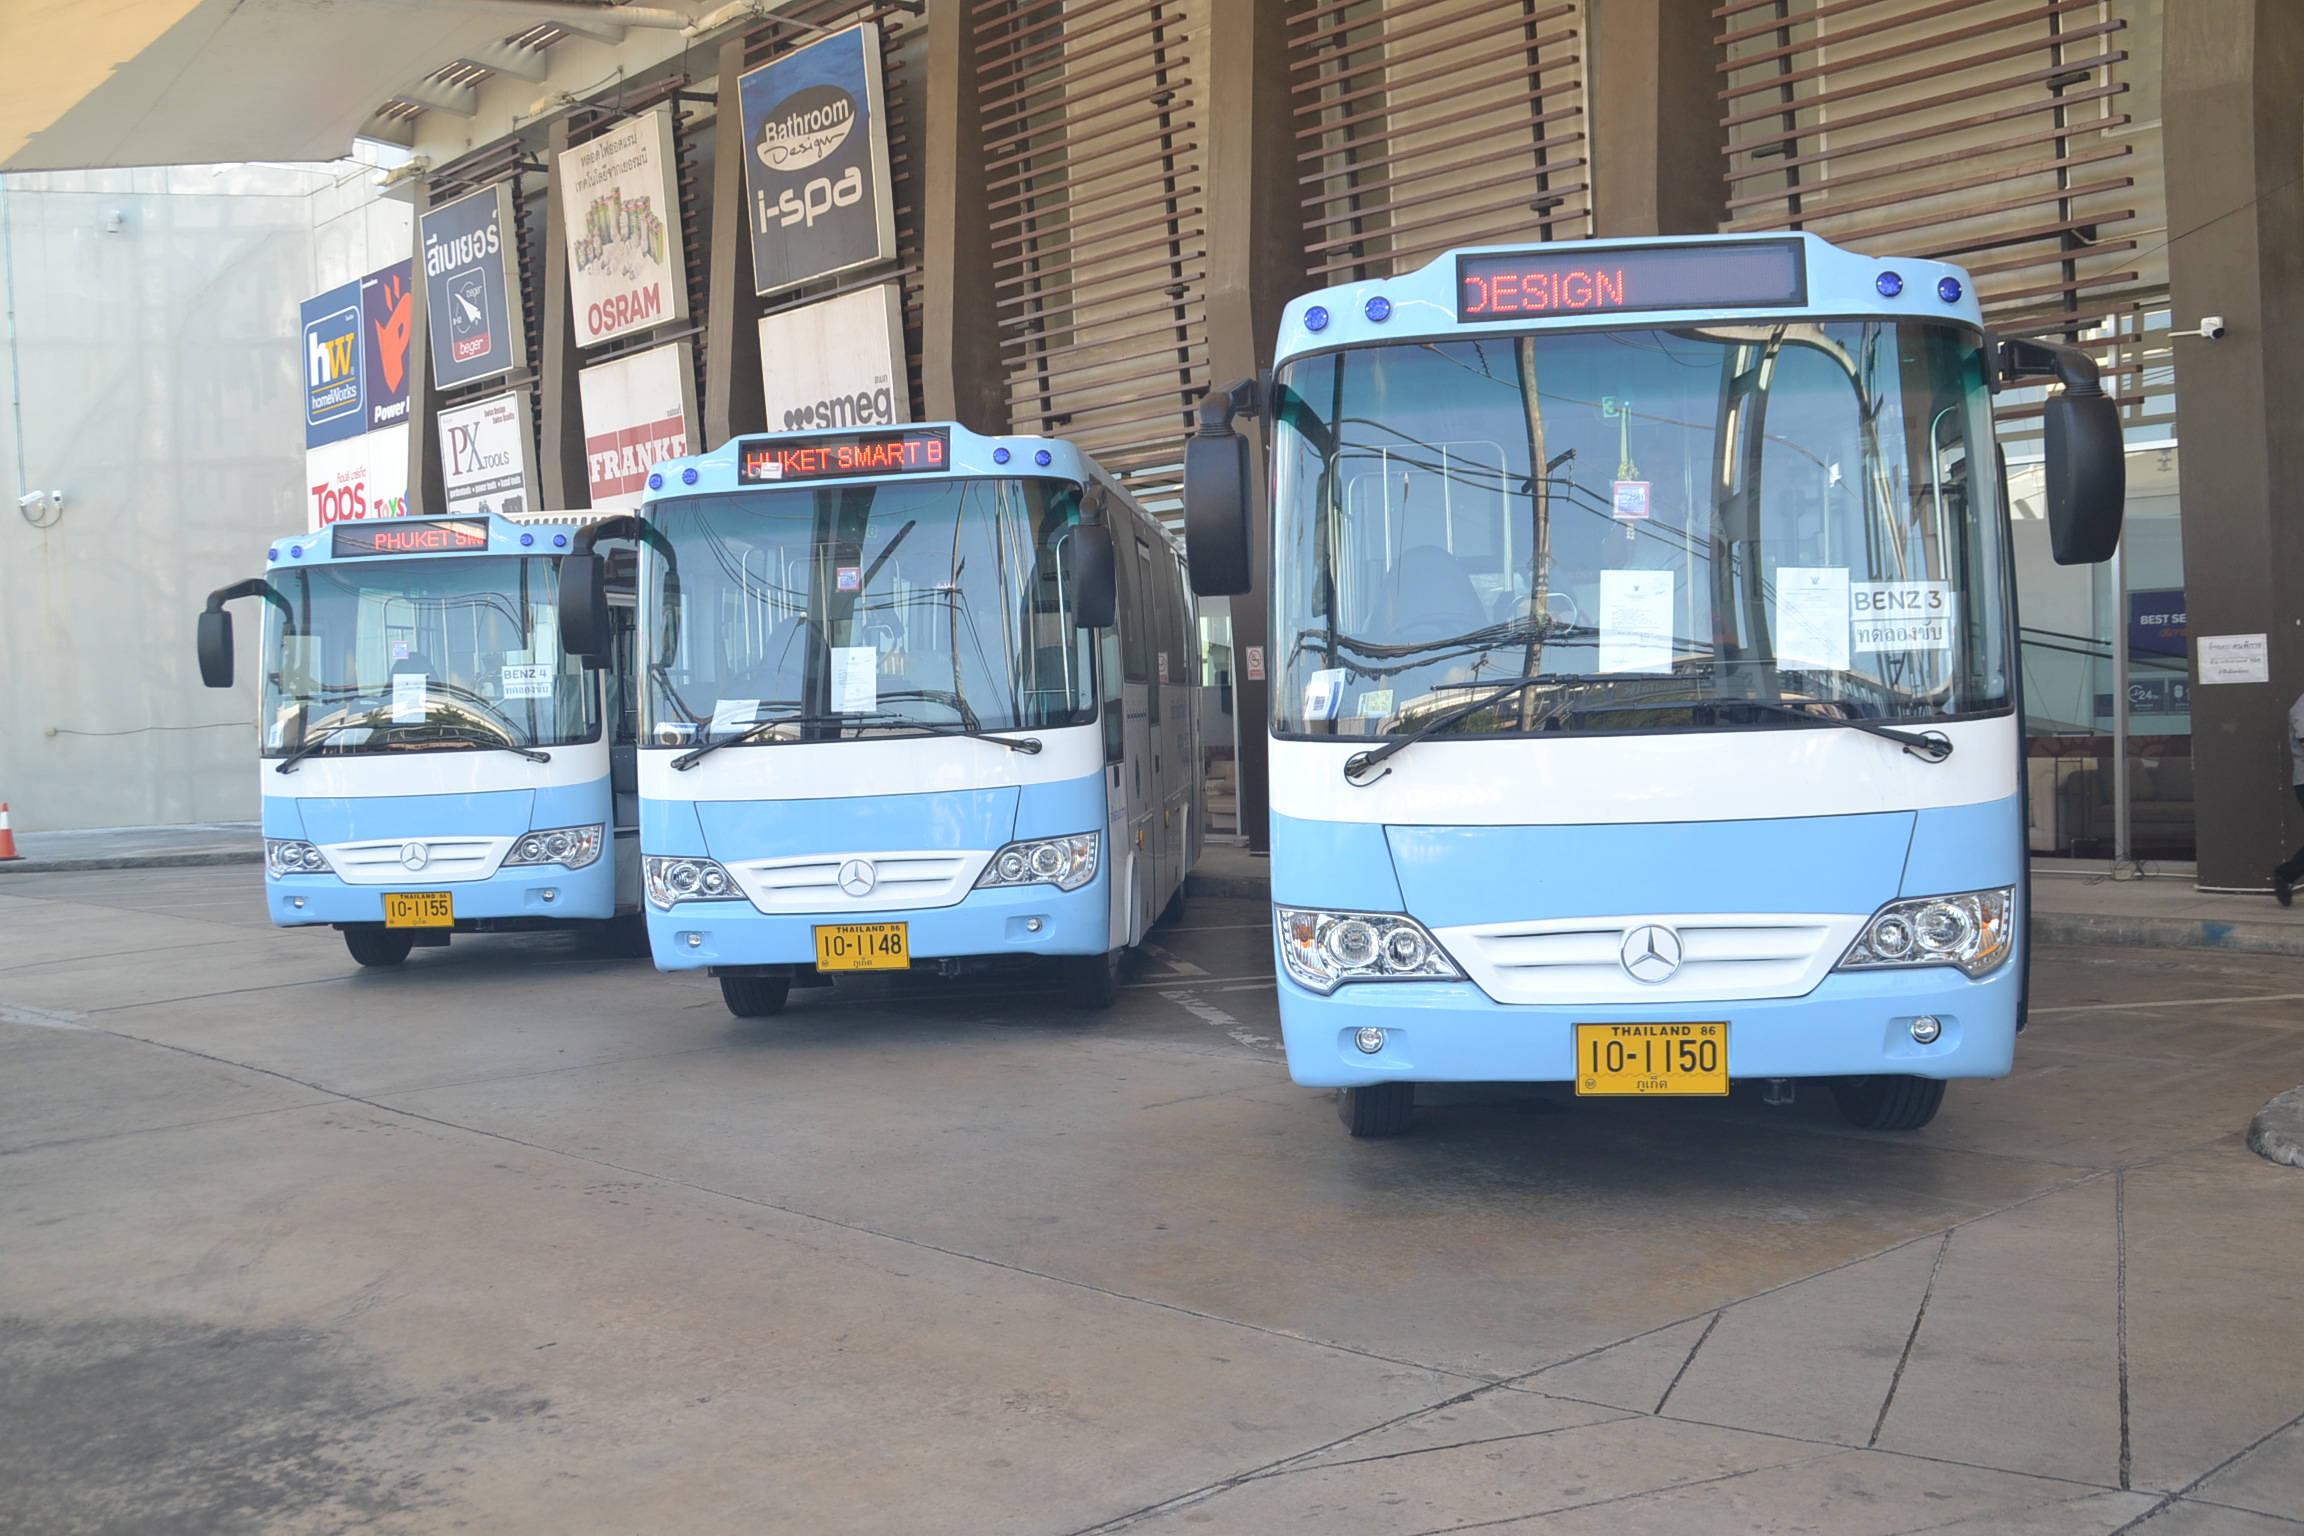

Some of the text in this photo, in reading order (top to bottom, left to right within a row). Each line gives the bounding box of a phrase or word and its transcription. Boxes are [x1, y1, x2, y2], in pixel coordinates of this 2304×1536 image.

[765, 99, 849, 143] Bathroom
[764, 132, 845, 164] Design
[757, 166, 863, 234] i-spa
[426, 209, 499, 277] สีเบเยอร์
[588, 282, 661, 336] OSRAM
[459, 338, 484, 356] beger
[312, 384, 357, 410] homeWorks
[815, 387, 893, 428] smeg
[374, 400, 406, 423] Power
[448, 421, 486, 476] PX
[483, 451, 510, 469] TOOLS
[589, 434, 687, 482] FRANKE
[838, 442, 921, 468] SMART
[927, 440, 943, 463] B
[375, 529, 452, 550] PHUKET
[1854, 590, 1942, 611] BENZ 3
[1856, 619, 1942, 643] ทดลองขับ
[2140, 614, 2169, 625] BEST
[504, 669, 547, 680] BENZ 4
[391, 900, 448, 917] 10-1155
[836, 925, 885, 933] THAILAND
[825, 933, 902, 957] 10-1148
[853, 956, 873, 968] ภูเก็ต
[1611, 1026, 1716, 1036] THAILAND 86
[1592, 1039, 1717, 1073] 10-1150
[1636, 1075, 1668, 1092] ภูเก็ต
